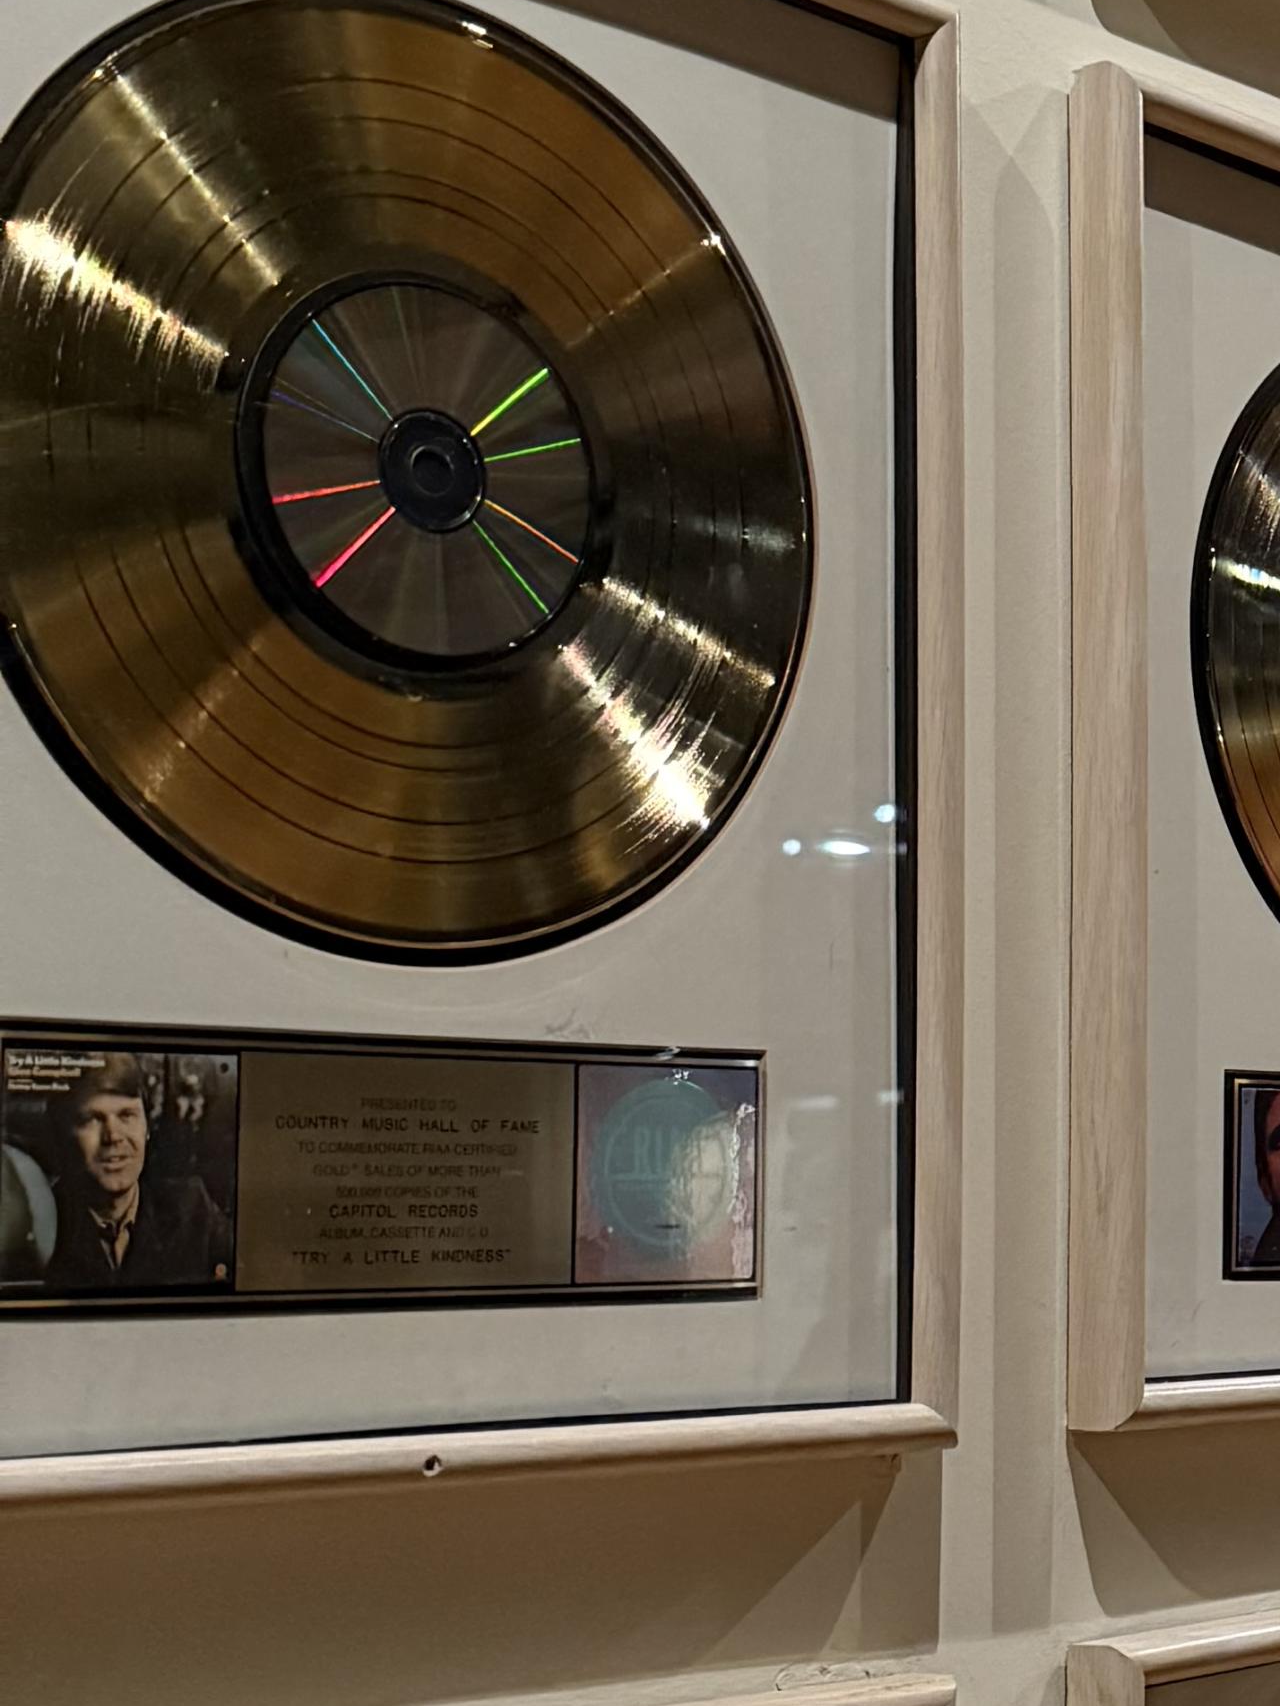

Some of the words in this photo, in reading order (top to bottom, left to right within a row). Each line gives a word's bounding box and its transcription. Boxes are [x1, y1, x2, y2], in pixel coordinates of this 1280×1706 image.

[275, 1114, 348, 1130] COUNTRY
[361, 1116, 408, 1131] MUSIC
[419, 1117, 458, 1132] HALL
[471, 1119, 489, 1133] OF
[500, 1119, 540, 1134] FAME
[329, 1204, 396, 1217] CAPITOL
[408, 1205, 478, 1218] RECORDS
[342, 1251, 353, 1264] A
[363, 1250, 420, 1263] LITTLE
